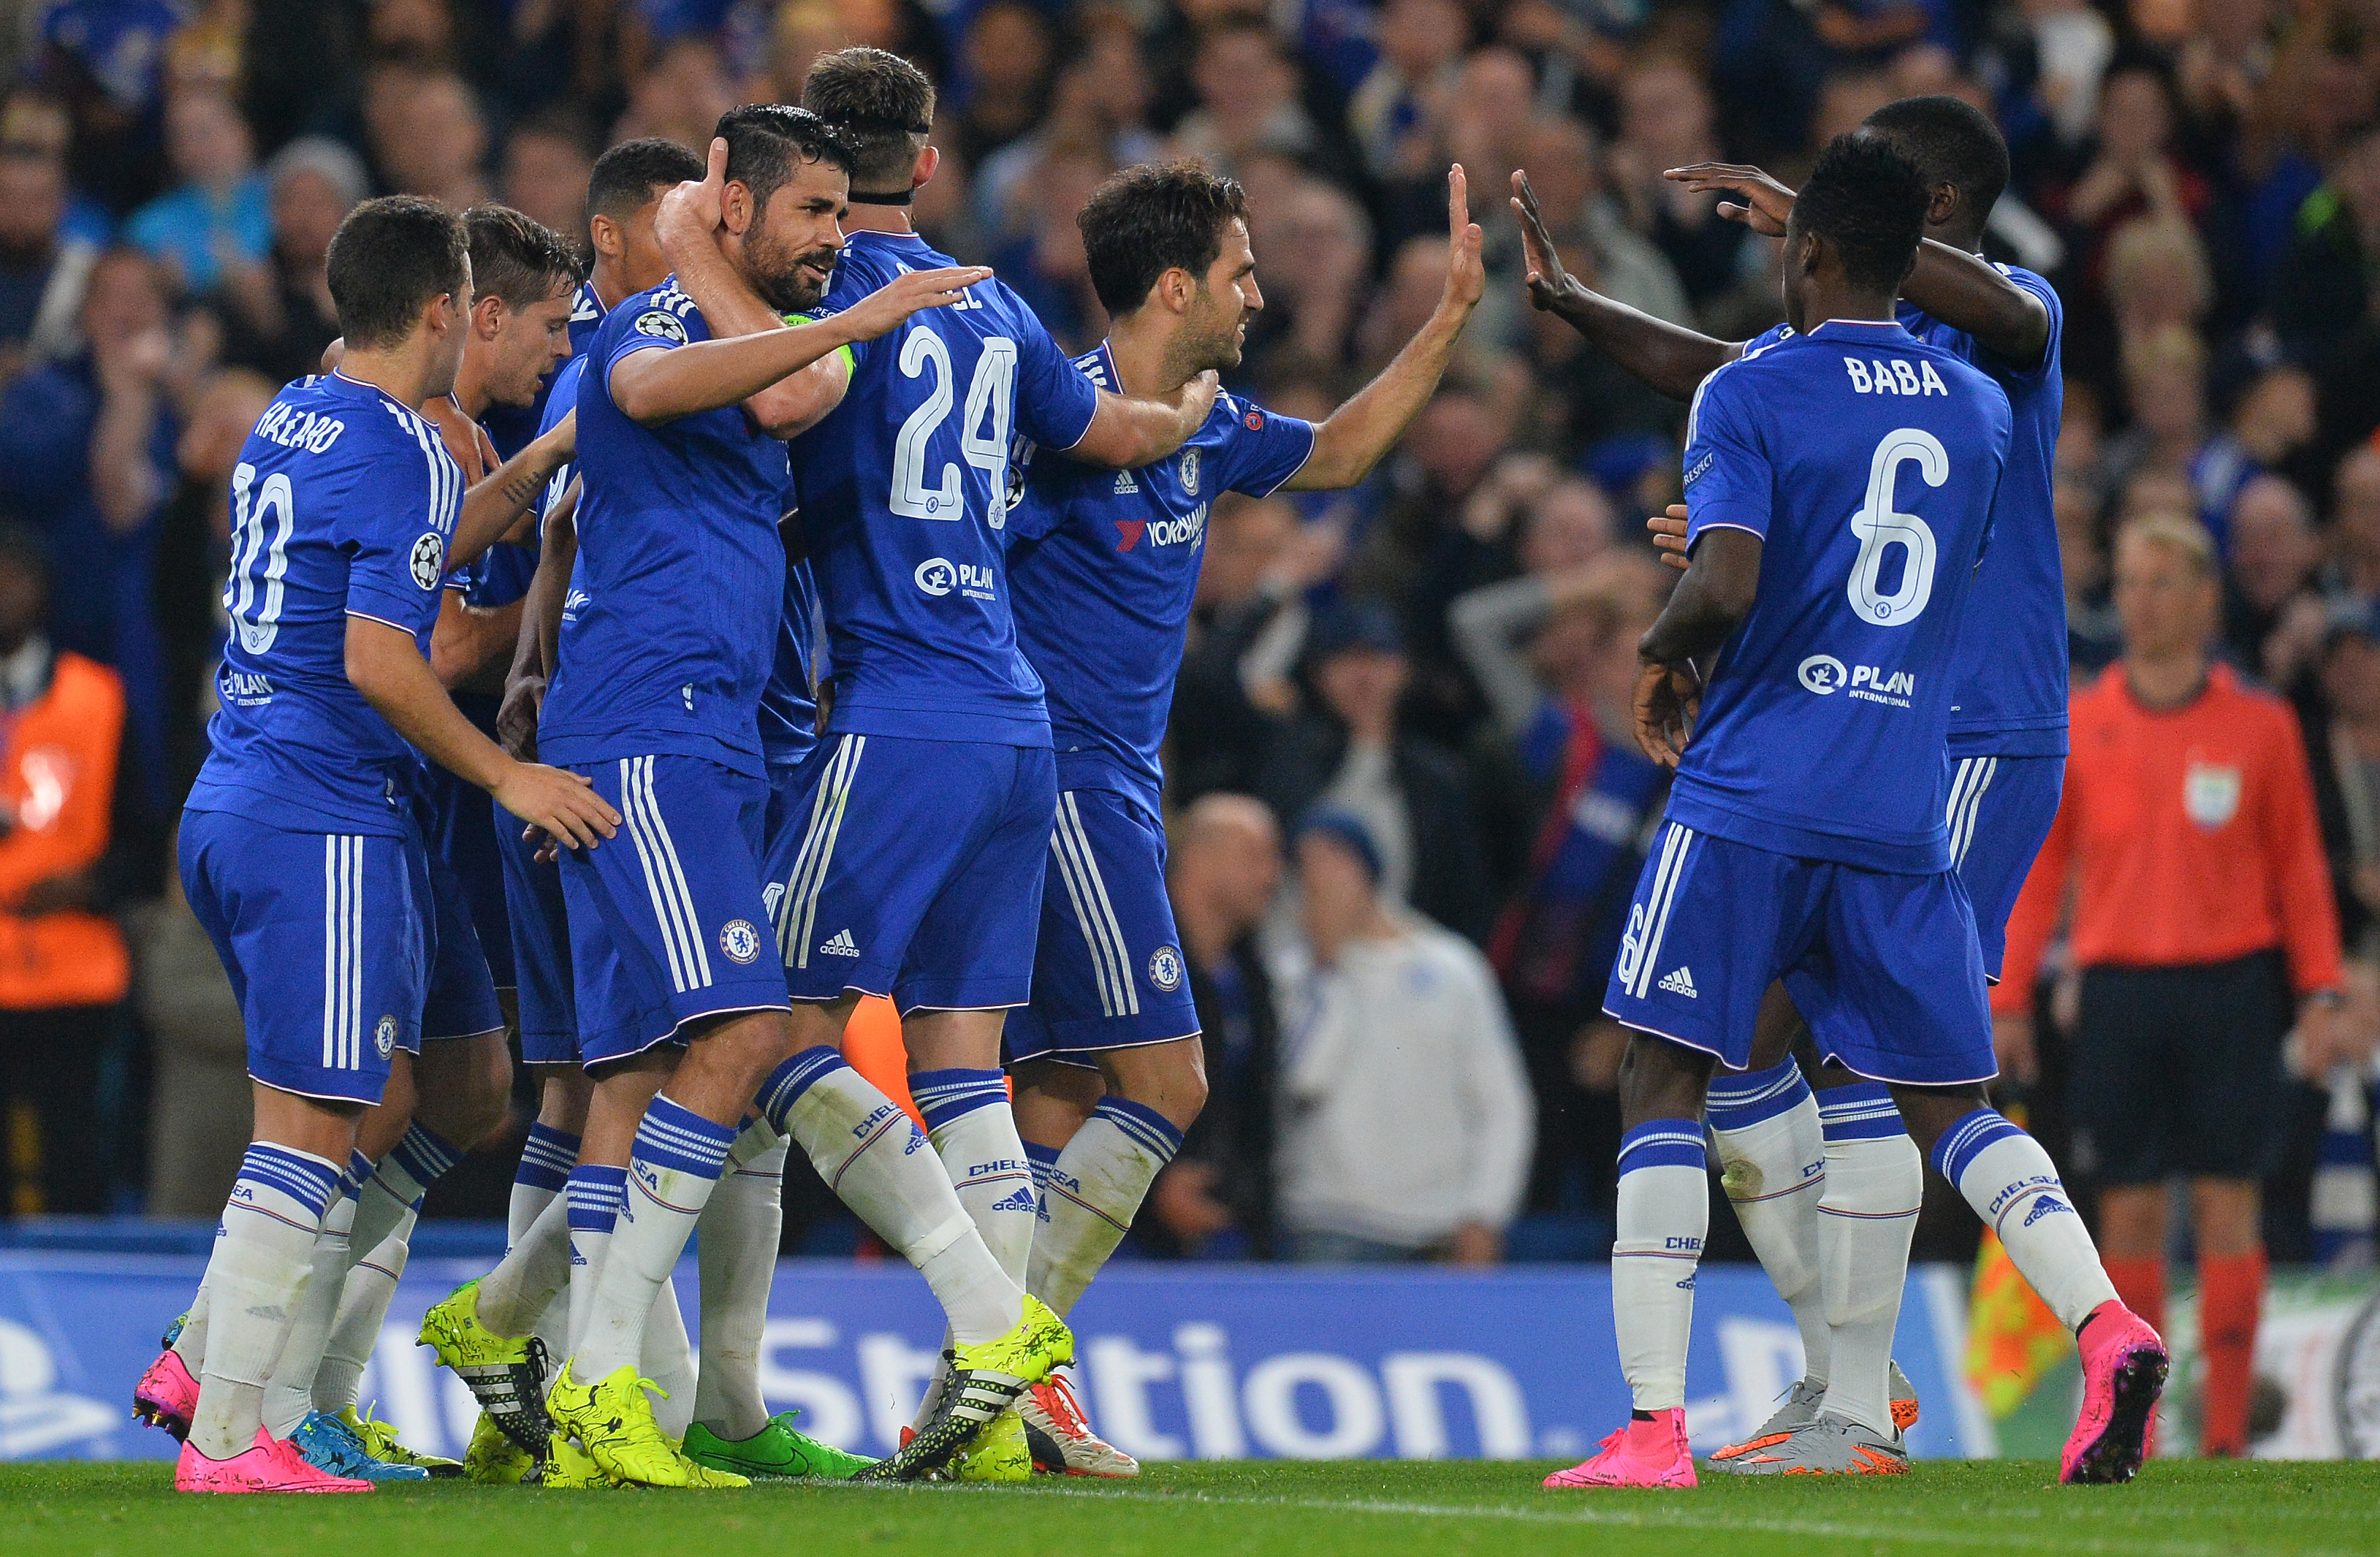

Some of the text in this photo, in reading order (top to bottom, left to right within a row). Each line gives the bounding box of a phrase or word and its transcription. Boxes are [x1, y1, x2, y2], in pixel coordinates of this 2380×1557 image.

[1844, 357, 1948, 396] BABA
[254, 400, 344, 454] HAZARD
[888, 325, 1017, 530] 24
[1684, 452, 1713, 486] RESPECT
[1114, 484, 1138, 495] adidas
[1847, 428, 1949, 627] 6
[959, 564, 994, 590] PLAN
[234, 673, 273, 695] PLAN
[1851, 665, 1915, 696] PLAN
[1848, 690, 1911, 708] INTERNATONAL
[819, 943, 860, 958] adidas
[1618, 902, 1644, 983] 6
[1657, 979, 1697, 999] adidas
